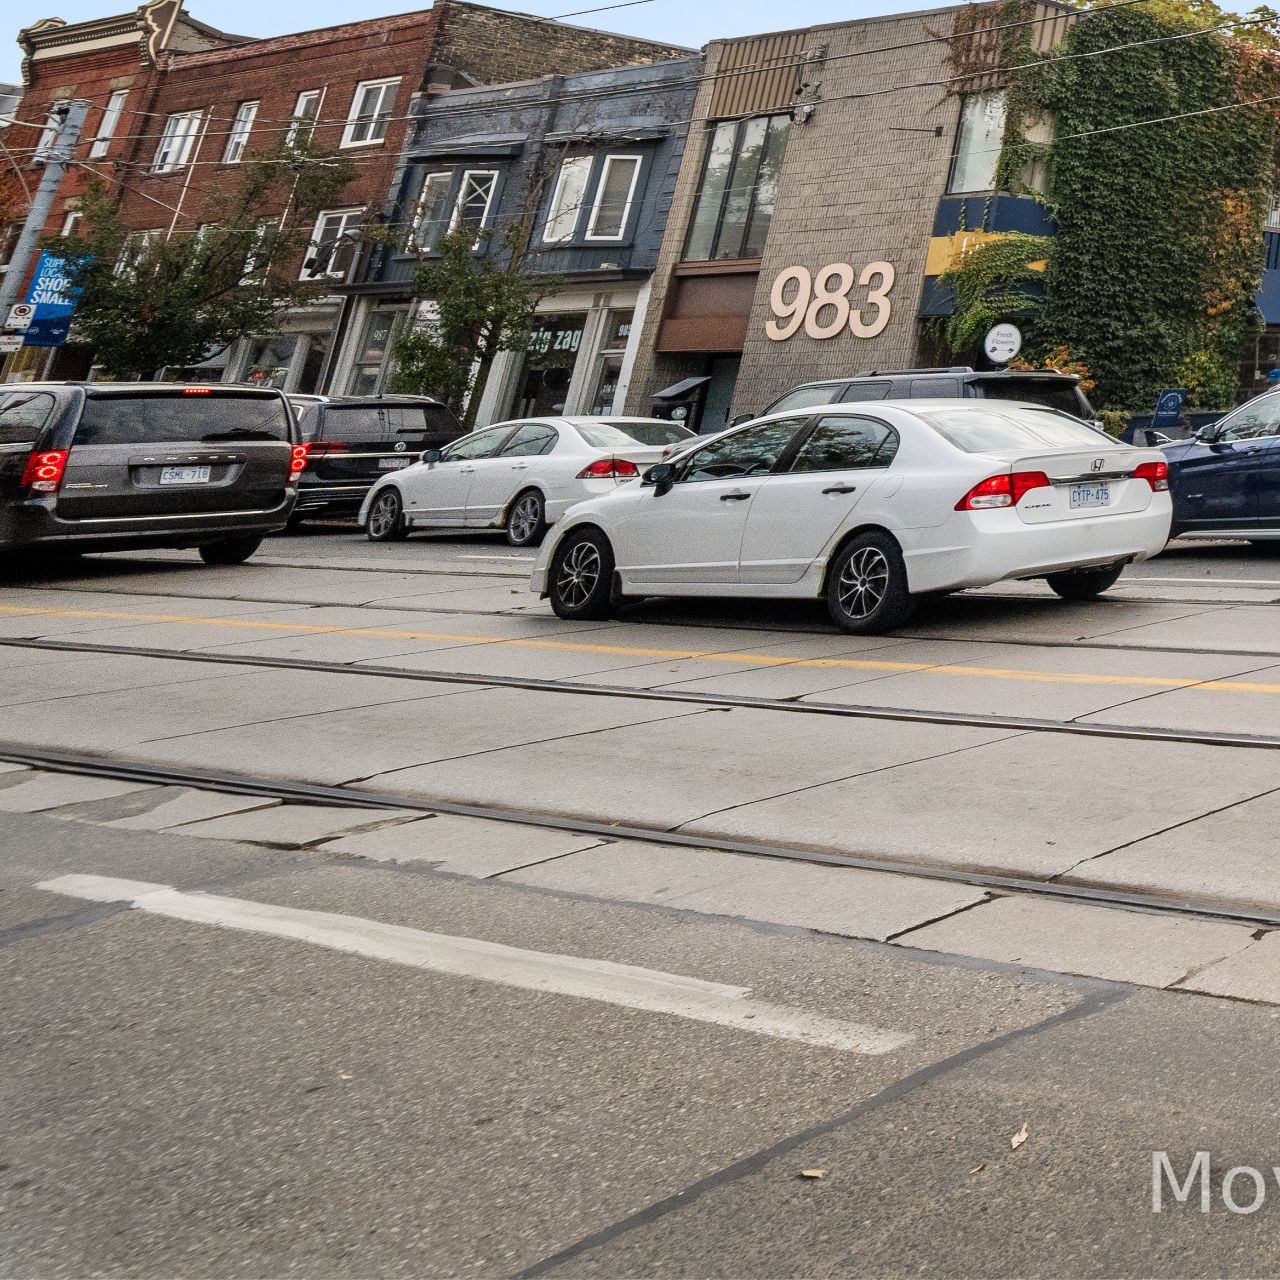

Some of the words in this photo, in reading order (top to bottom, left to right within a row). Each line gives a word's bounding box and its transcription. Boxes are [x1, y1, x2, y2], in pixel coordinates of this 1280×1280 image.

[765, 261, 895, 341] 983
[526, 327, 553, 354] zig
[553, 329, 583, 353] zag
[992, 338, 1016, 346] Flowers
[1072, 490, 1091, 502] CYTP
[1095, 488, 1109, 501] 475
